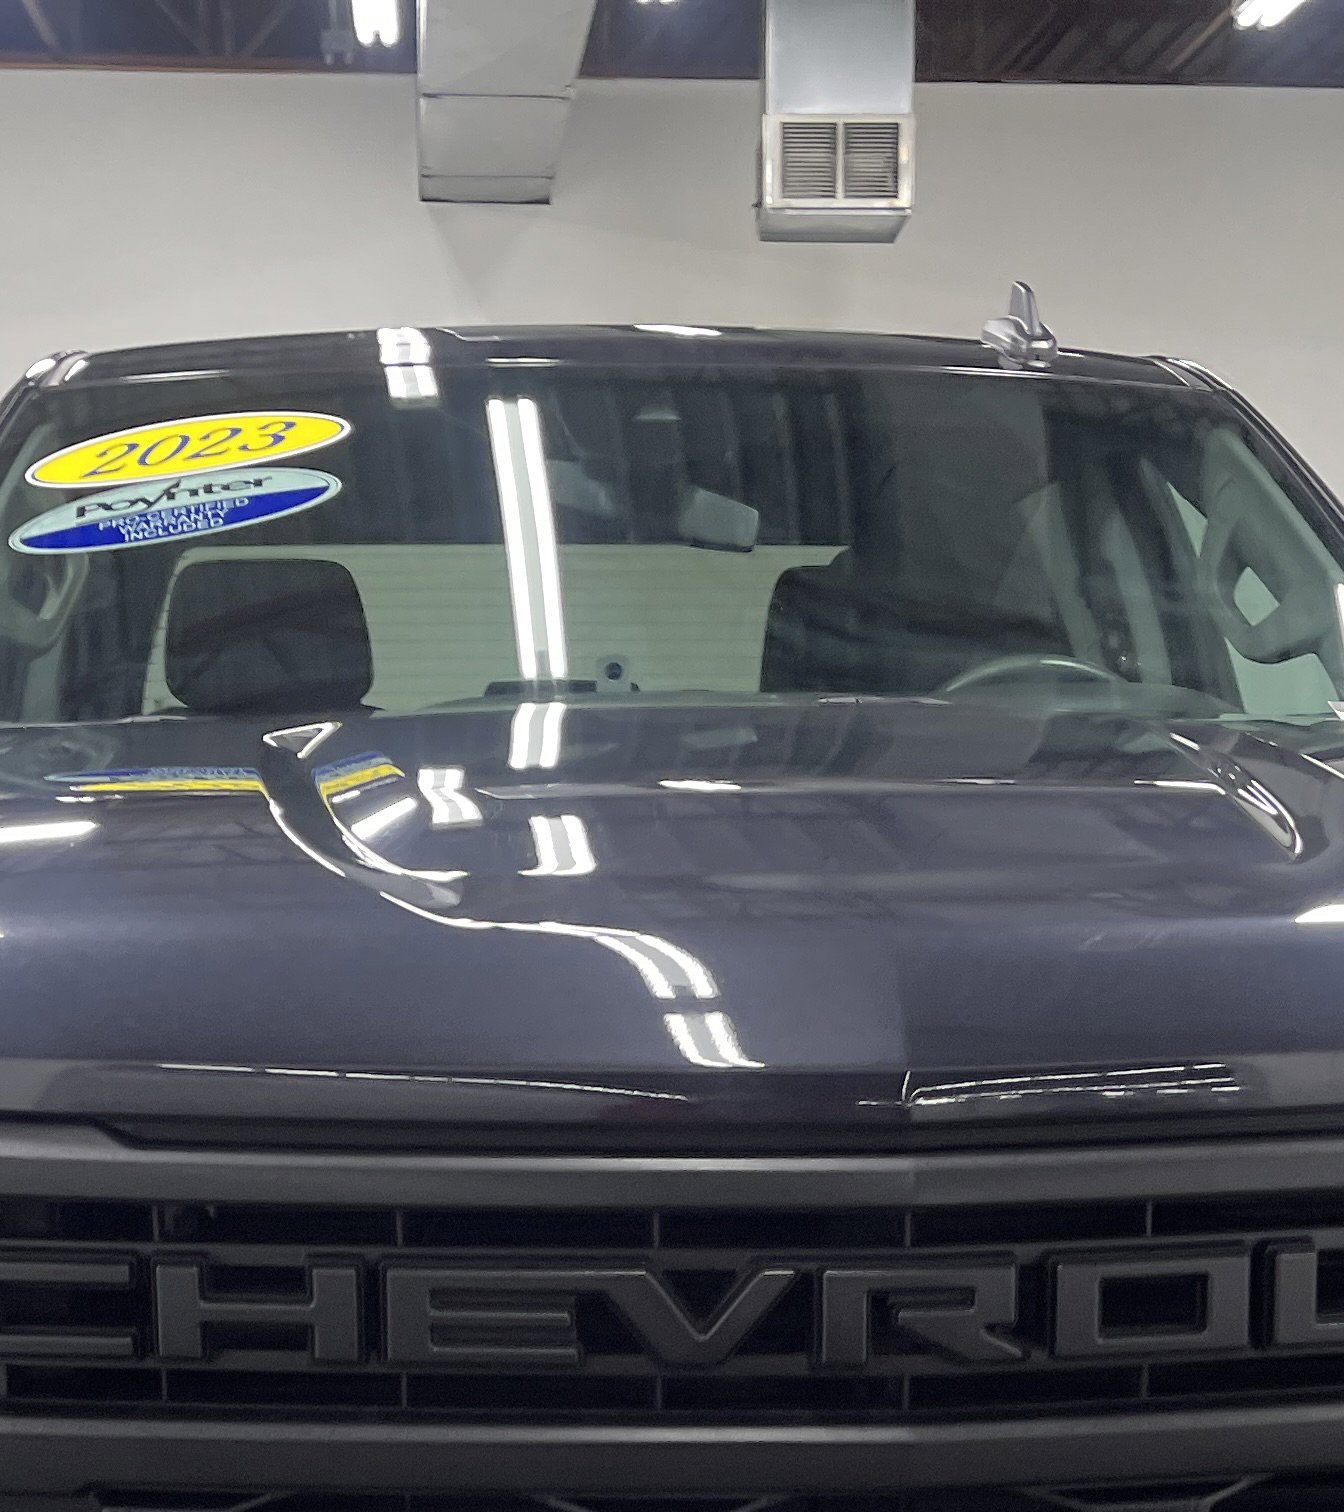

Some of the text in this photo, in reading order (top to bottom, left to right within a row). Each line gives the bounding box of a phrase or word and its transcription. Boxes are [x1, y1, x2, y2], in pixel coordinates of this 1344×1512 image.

[82, 421, 297, 477] 2023
[75, 476, 273, 519] Poynter
[118, 509, 228, 536] WARRANTY
[123, 517, 224, 543] INCLUDED
